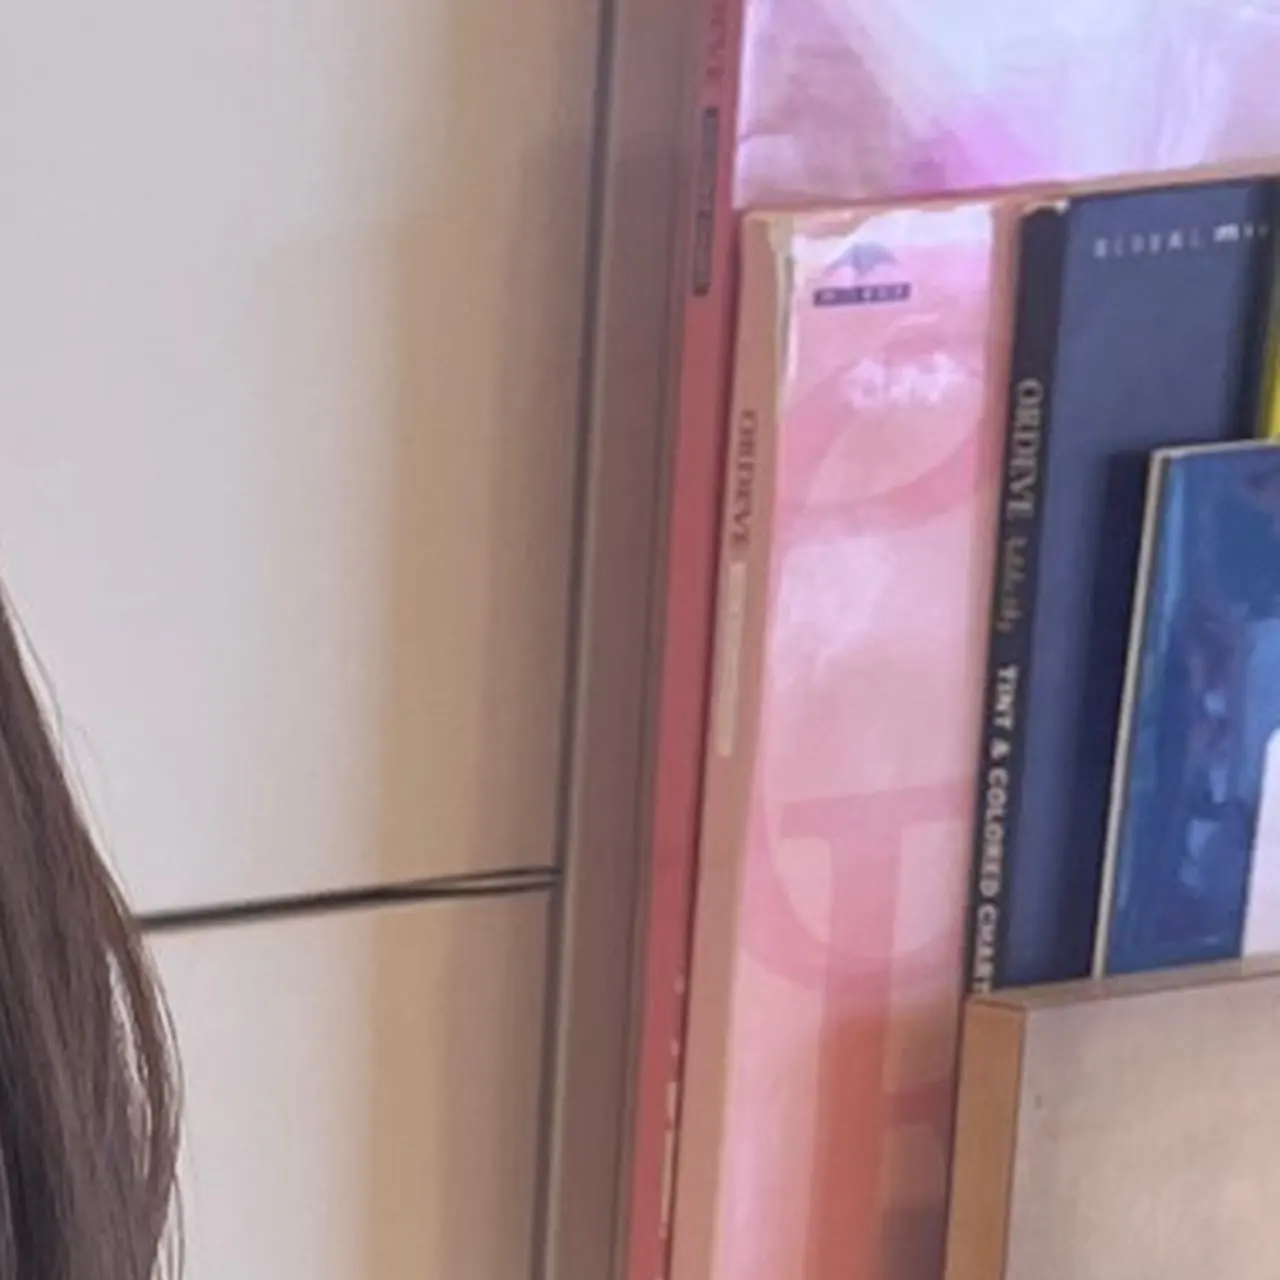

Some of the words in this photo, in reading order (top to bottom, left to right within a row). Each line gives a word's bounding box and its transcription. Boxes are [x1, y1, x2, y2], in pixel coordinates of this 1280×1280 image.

[993, 663, 1018, 730] TINT
[979, 767, 1009, 897] COLORED
[971, 903, 999, 994] CHART
